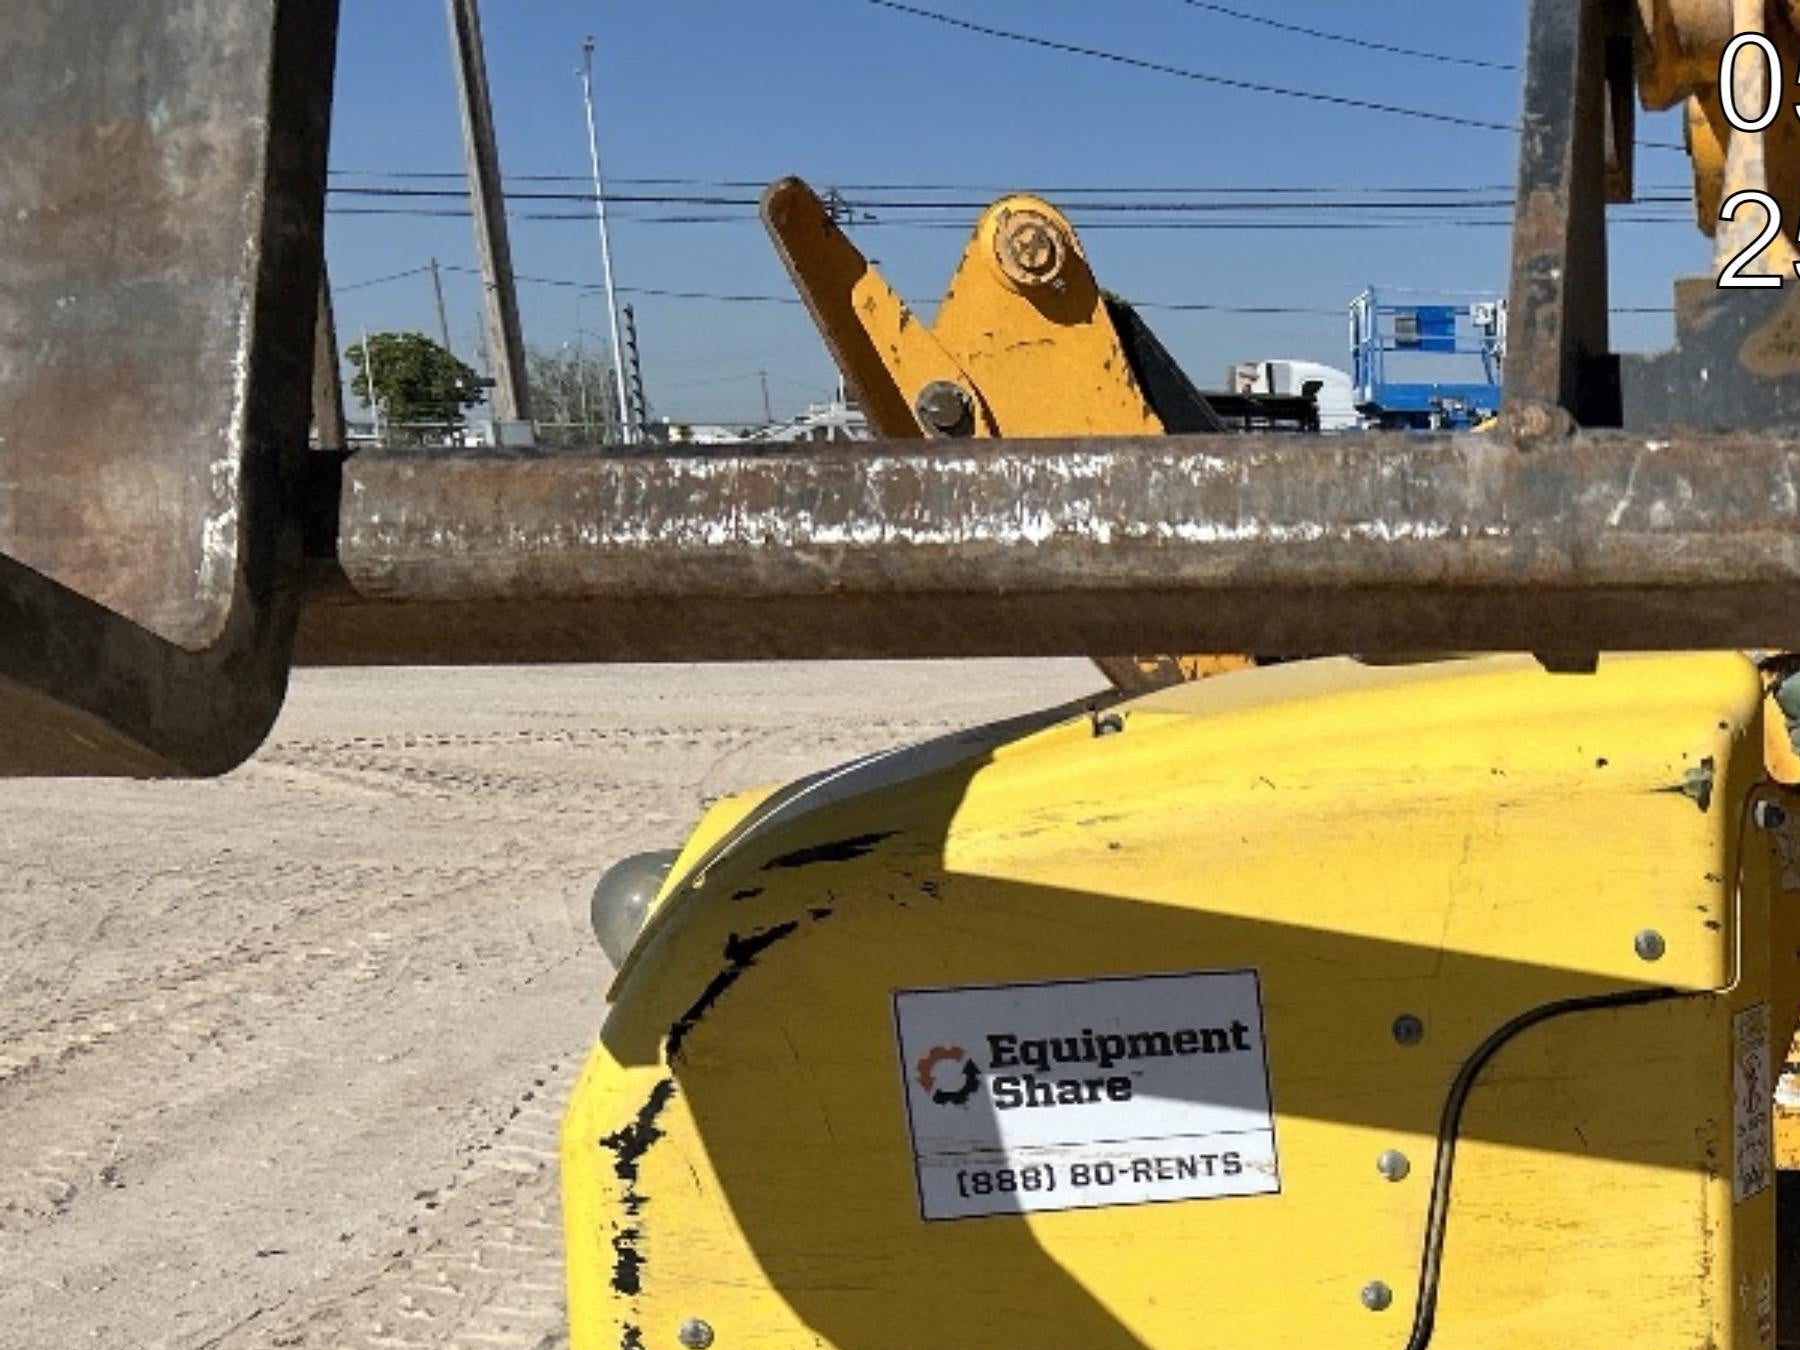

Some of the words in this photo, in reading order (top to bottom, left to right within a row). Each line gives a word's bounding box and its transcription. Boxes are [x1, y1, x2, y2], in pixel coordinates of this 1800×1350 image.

[986, 1019, 1251, 1070] Equipment
[991, 1074, 1132, 1110] Share
[957, 1164, 1056, 1198] (888)
